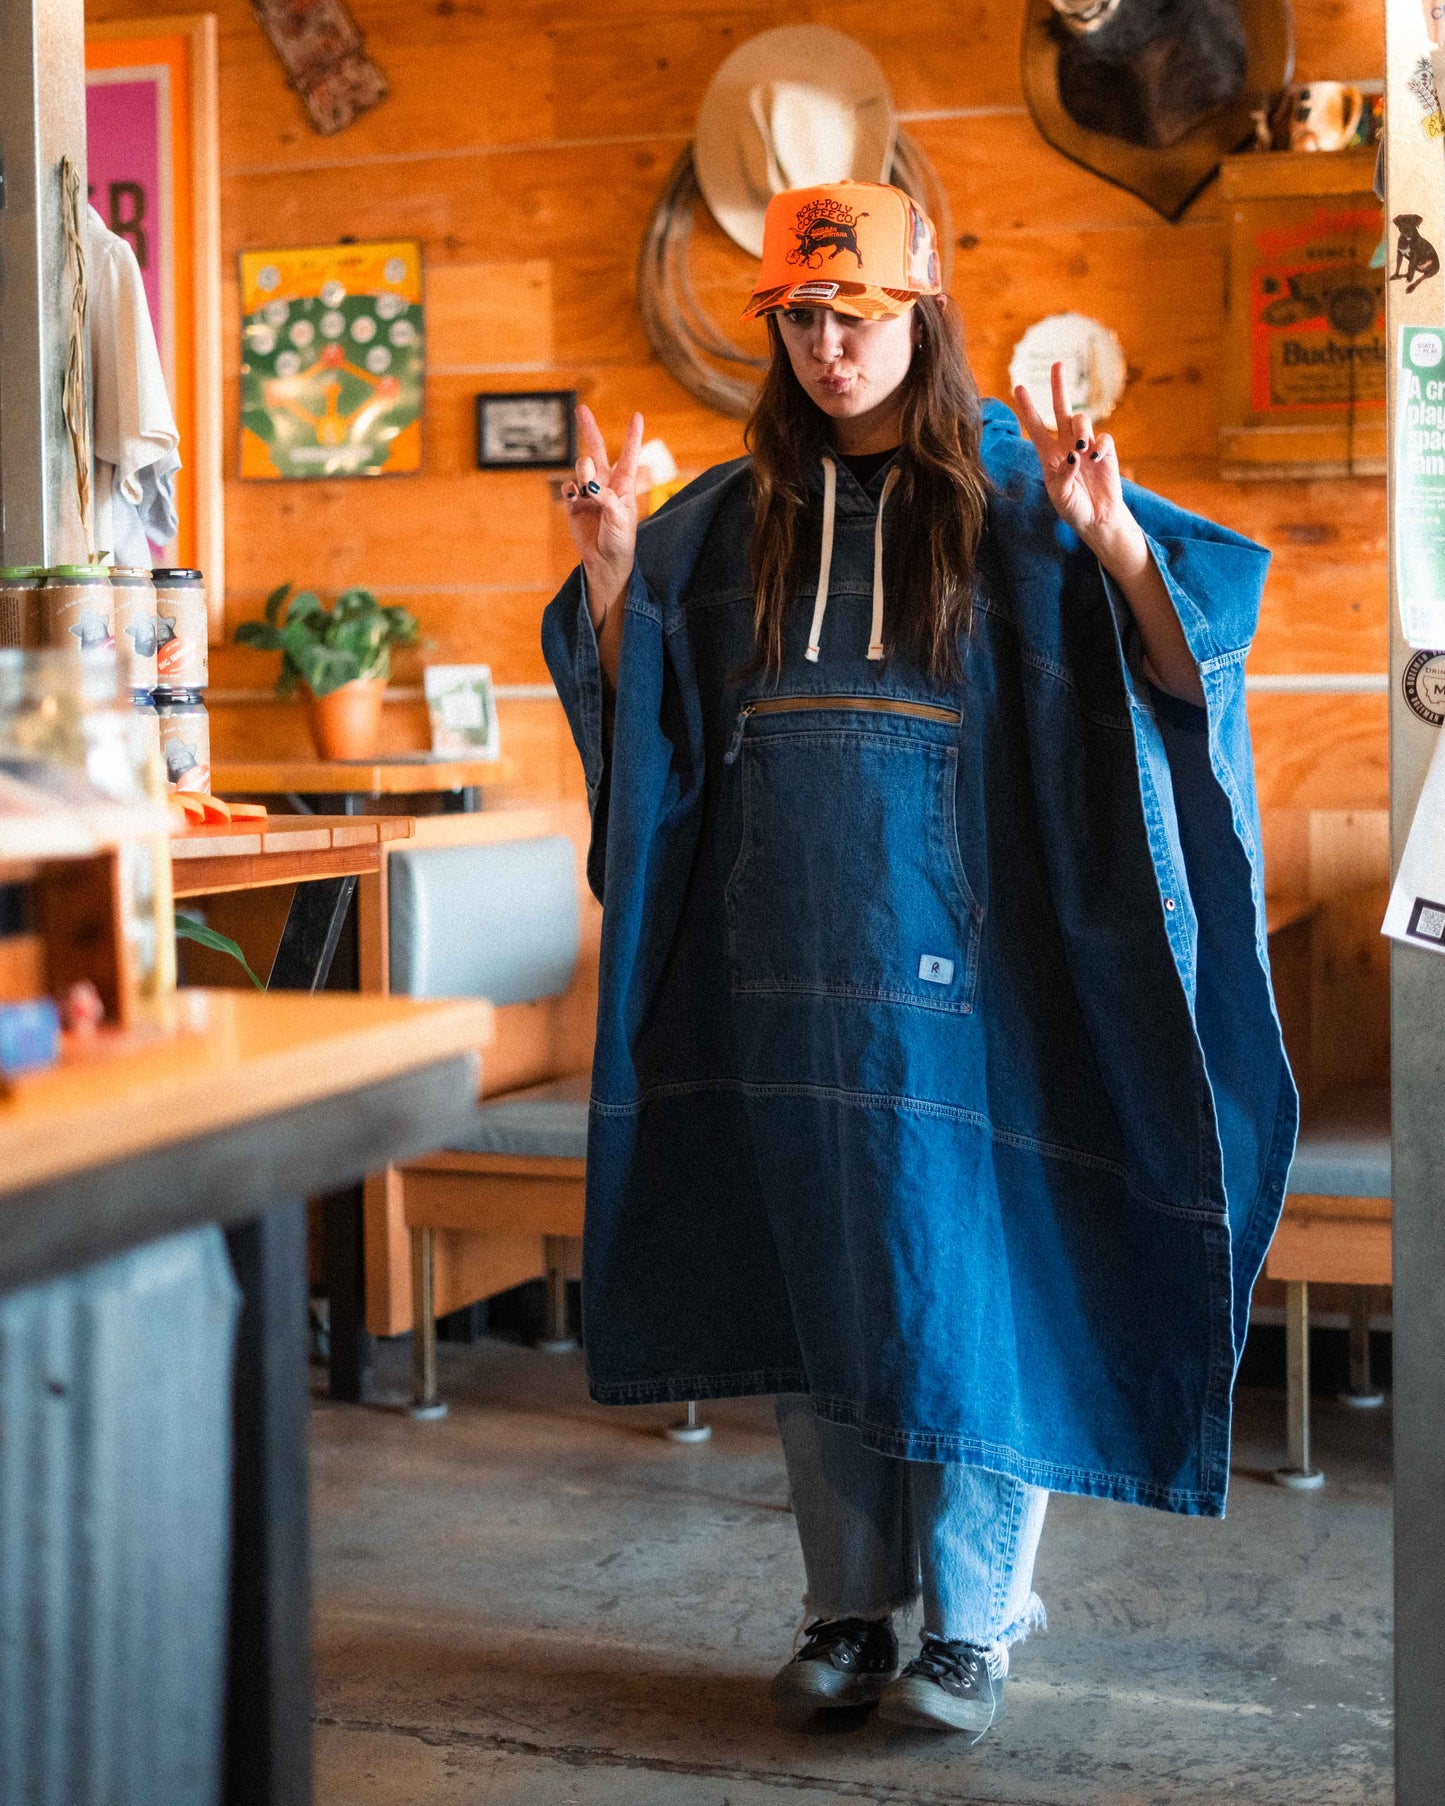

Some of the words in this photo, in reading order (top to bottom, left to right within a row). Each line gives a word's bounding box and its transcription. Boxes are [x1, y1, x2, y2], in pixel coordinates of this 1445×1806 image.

[797, 199, 853, 220] ROLY-POLY
[798, 208, 836, 229] COFFEE
[836, 213, 854, 225] CO.
[88, 181, 148, 269] R
[1407, 375, 1421, 399] A
[1407, 400, 1445, 430] play
[1408, 454, 1444, 476] am
[1407, 653, 1430, 686] BOZEMAN
[1411, 697, 1439, 723] BOZEMAN
